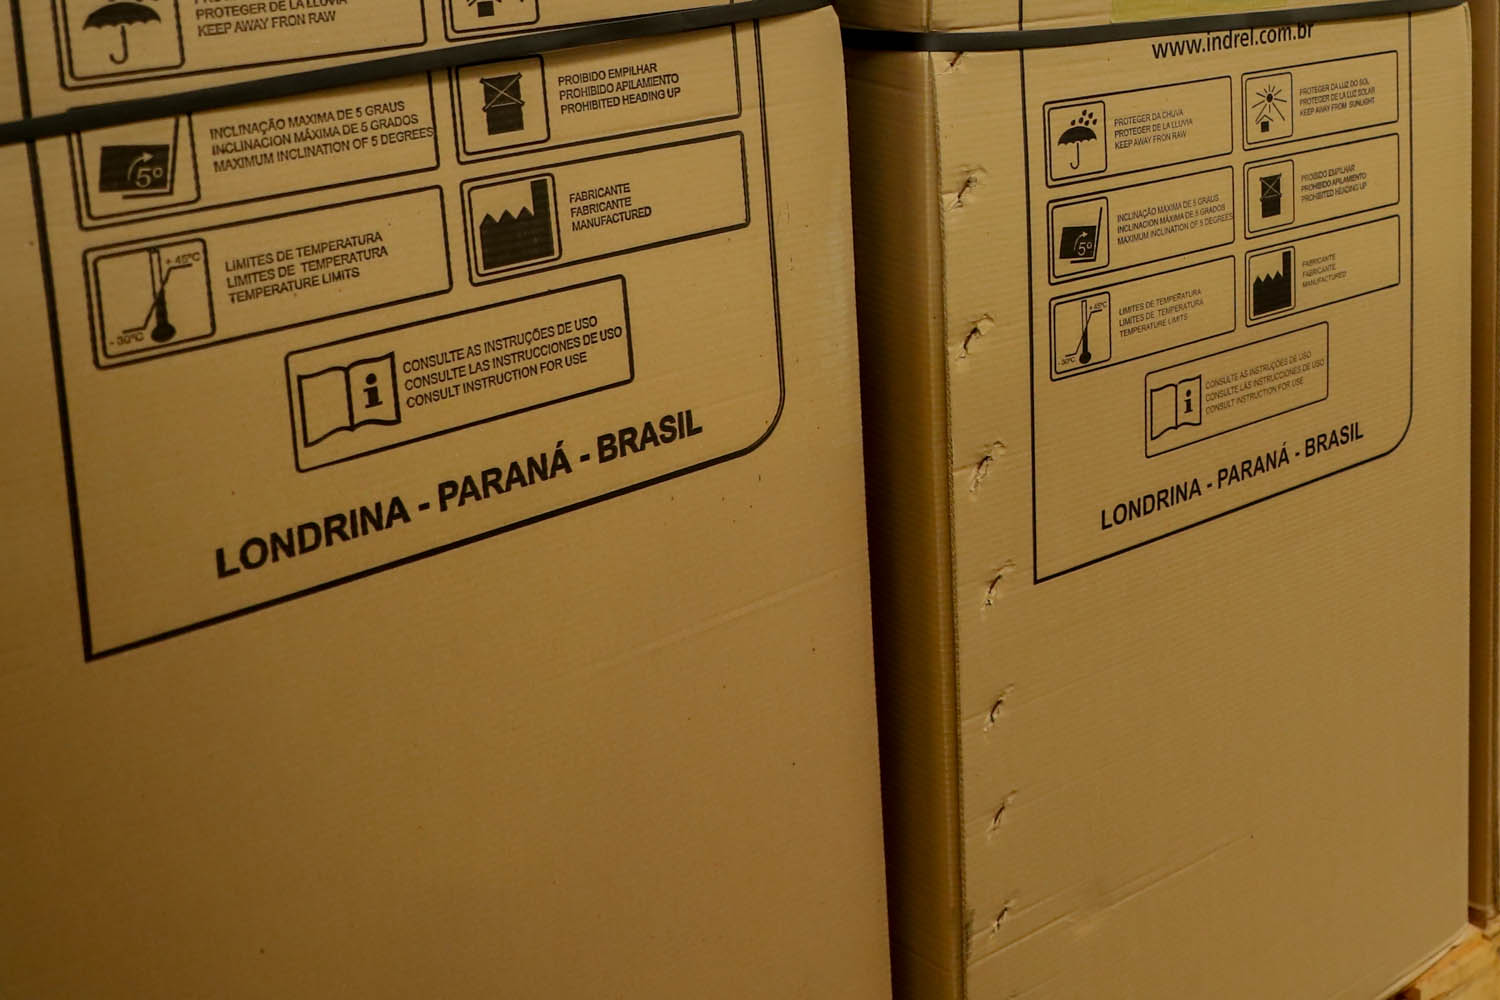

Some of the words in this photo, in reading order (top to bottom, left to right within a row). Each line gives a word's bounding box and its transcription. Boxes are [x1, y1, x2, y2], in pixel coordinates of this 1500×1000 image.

[196, 2, 267, 20] PROTEGER
[269, 0, 286, 12] DE
[289, 0, 305, 10] LA
[197, 22, 232, 37] KEEP
[234, 18, 270, 33] AWAY
[308, 10, 336, 25] RAW
[1152, 22, 1315, 59] www.indrel.com.br
[558, 70, 606, 86] PROIBIDO
[608, 63, 657, 79] EMPILHAR
[559, 83, 614, 100] PROHIBIDO
[616, 73, 679, 92] APILAMIENTO
[560, 96, 620, 114] PROHIBITED
[622, 89, 665, 105] HEADING
[667, 87, 681, 98] UP
[209, 117, 286, 140] INCLINAÇÃO
[337, 109, 353, 120] DE
[355, 107, 363, 117] 5
[365, 101, 405, 117] GRAUS
[342, 123, 357, 135] DE
[360, 122, 368, 132] 5
[370, 114, 419, 131] GRADOS
[213, 154, 274, 173] MAXIMUM
[277, 141, 350, 162] INCLINATION
[352, 137, 368, 150] OF
[371, 136, 378, 146] 5
[381, 126, 434, 145] DEGREES
[569, 183, 631, 203] FABRICANTE
[570, 197, 632, 218] FABRICANTE
[572, 206, 652, 231] MANUFACTURED
[225, 252, 274, 272] LIMITES
[276, 250, 294, 262] DE
[296, 231, 383, 257] TEMPERATURA
[226, 269, 276, 288] LIMITES
[278, 265, 296, 278] DE
[301, 245, 388, 273] TEMPERATURA
[229, 275, 320, 304] TEMPERATURE
[322, 267, 360, 284] LIMITS
[403, 348, 465, 374] CONSULTE
[466, 343, 481, 359] AS
[484, 326, 555, 353] INSTRUÇÕES
[557, 321, 572, 336] DE
[574, 316, 598, 331] USO
[404, 364, 467, 391] CONSULTE
[469, 358, 490, 375] LAS
[492, 337, 581, 370] INSTRUCCIONES
[583, 331, 598, 346] DE
[600, 326, 622, 342] USO
[406, 384, 460, 408] CONSULT
[463, 363, 538, 394] INSTRUCTION
[540, 355, 563, 374] FOR
[565, 351, 588, 367] USE
[215, 495, 412, 579] LONDRINA
[438, 440, 573, 513] PARANÁ
[597, 409, 703, 465] BRASIL
[1101, 478, 1202, 530] LONDRINA
[1217, 441, 1290, 489] PARANÁ
[1305, 421, 1364, 458] BRASIL
